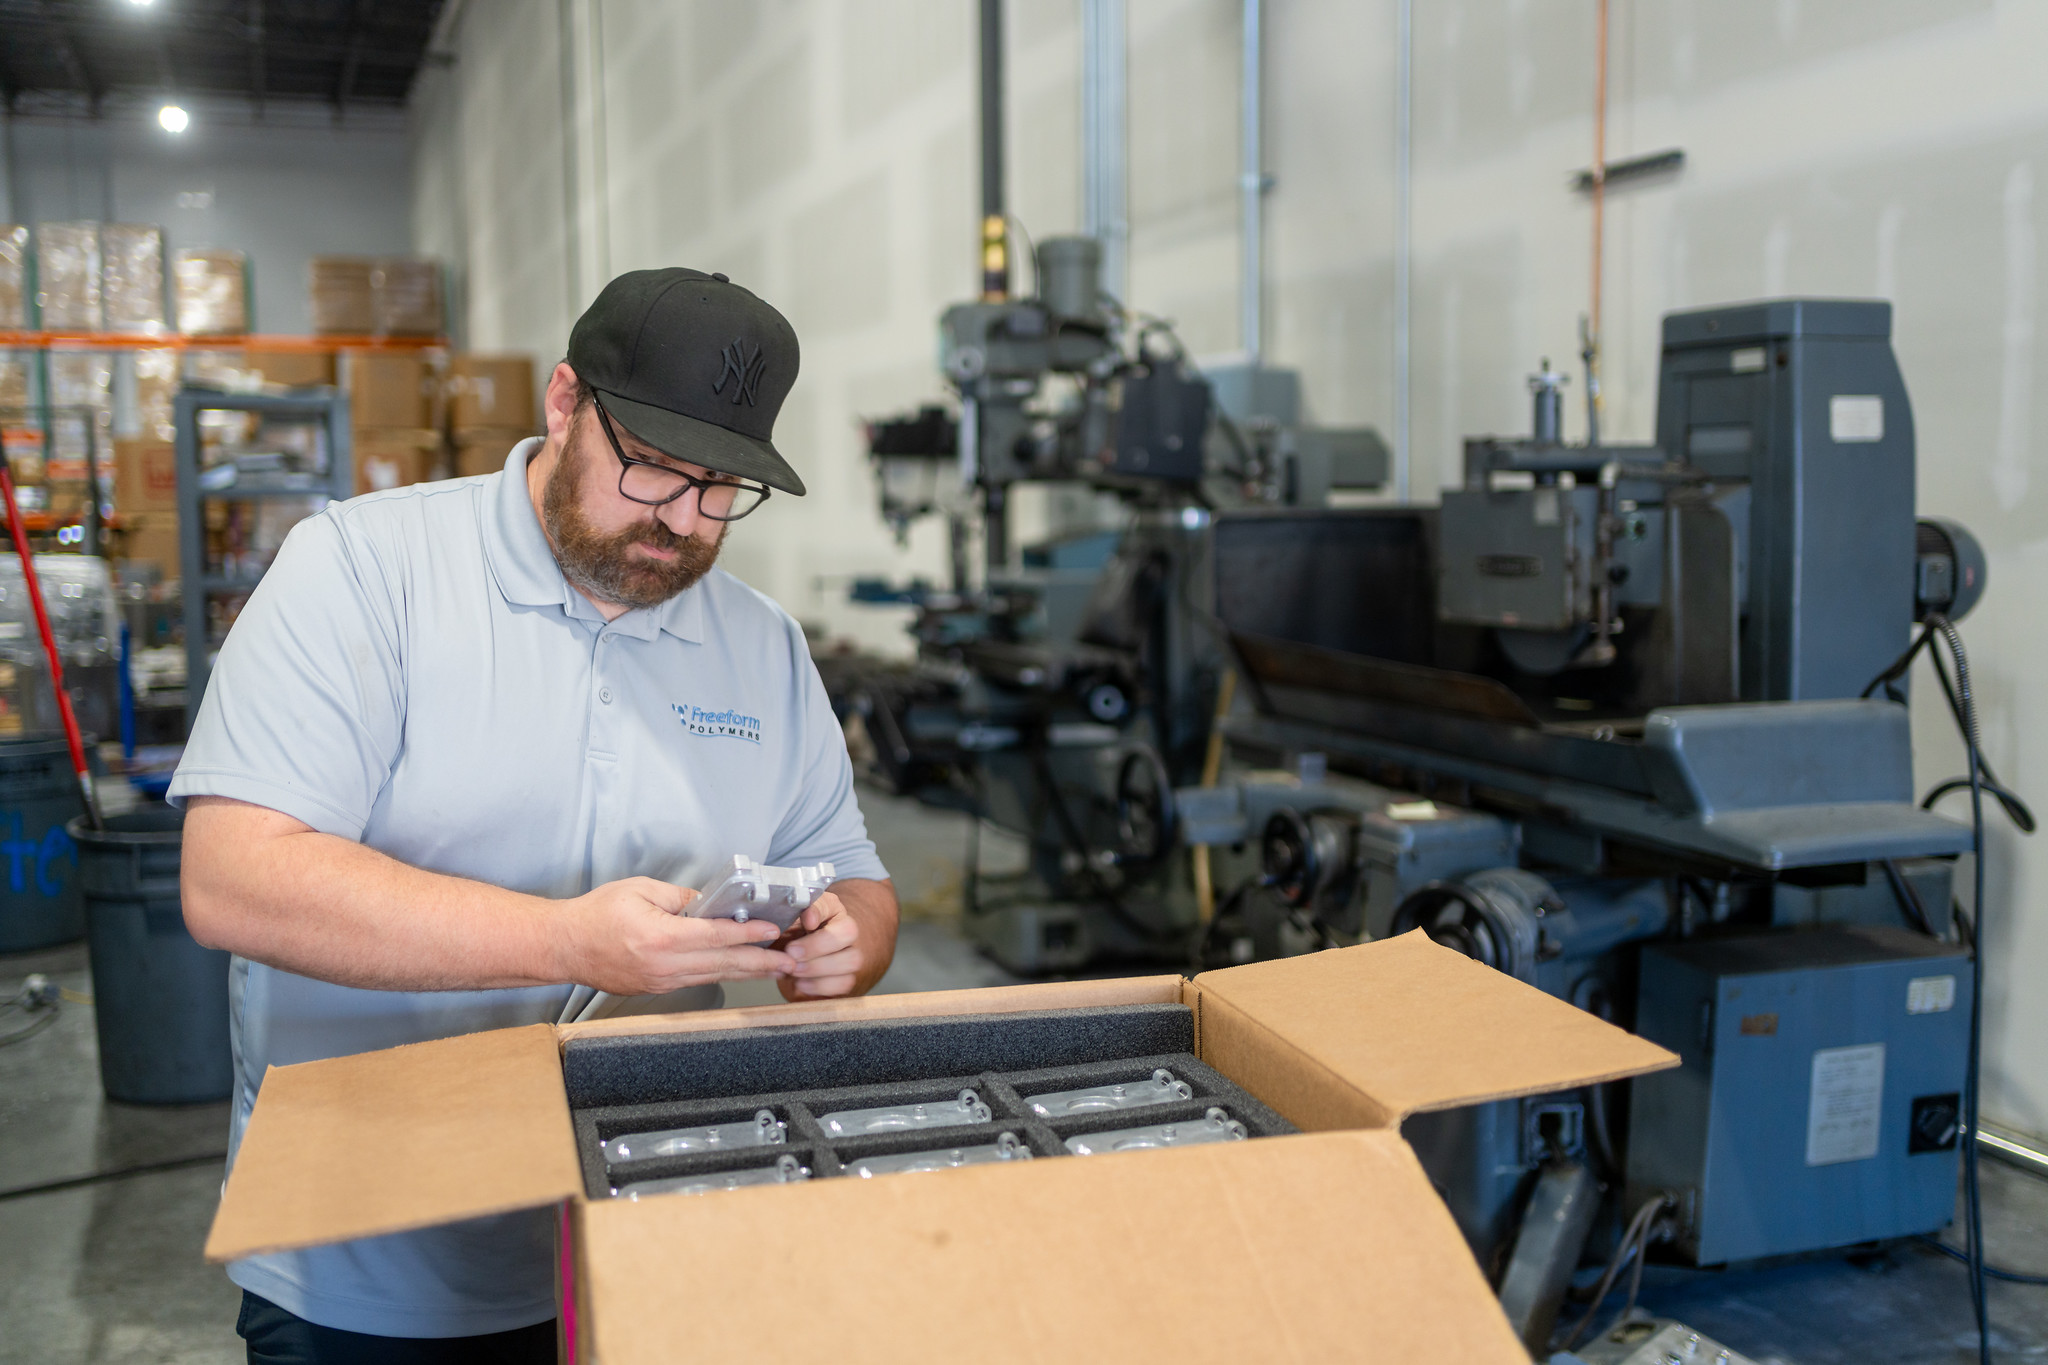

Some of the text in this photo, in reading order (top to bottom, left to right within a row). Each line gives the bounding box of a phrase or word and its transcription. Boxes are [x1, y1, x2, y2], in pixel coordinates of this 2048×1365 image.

[712, 336, 767, 407] NY
[691, 706, 760, 730] Freeform
[689, 724, 760, 741] POLYMERS
